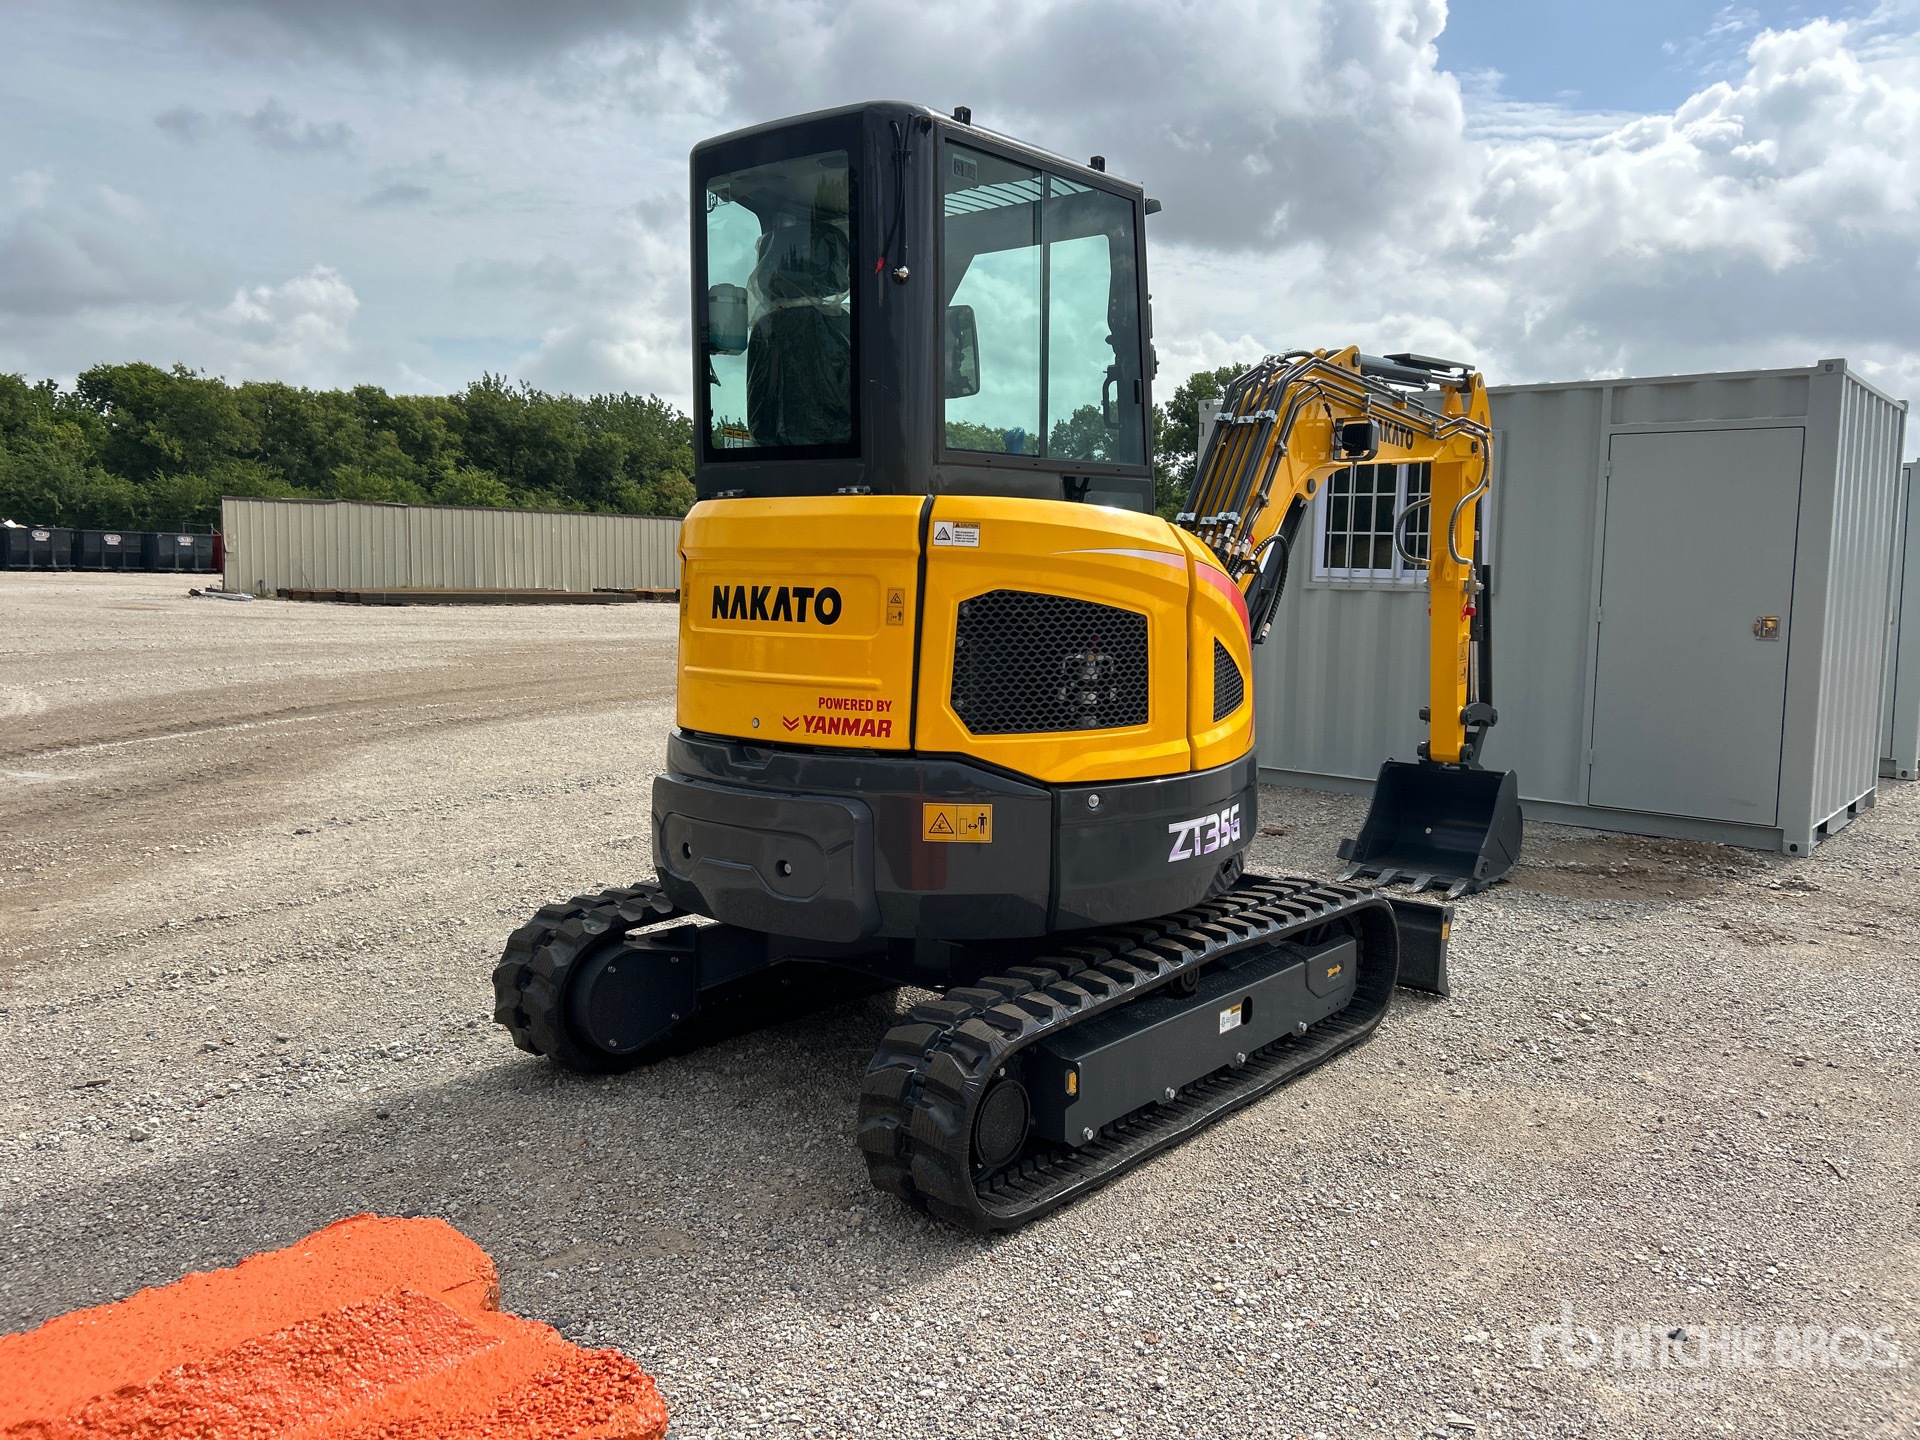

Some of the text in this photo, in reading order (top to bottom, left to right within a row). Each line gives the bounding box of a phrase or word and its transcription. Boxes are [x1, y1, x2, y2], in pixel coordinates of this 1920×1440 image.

[1368, 416, 1414, 450] AKATO
[712, 585, 842, 625] NAKATO
[818, 697, 892, 712] POWERED BY
[803, 715, 892, 738] YANMAR
